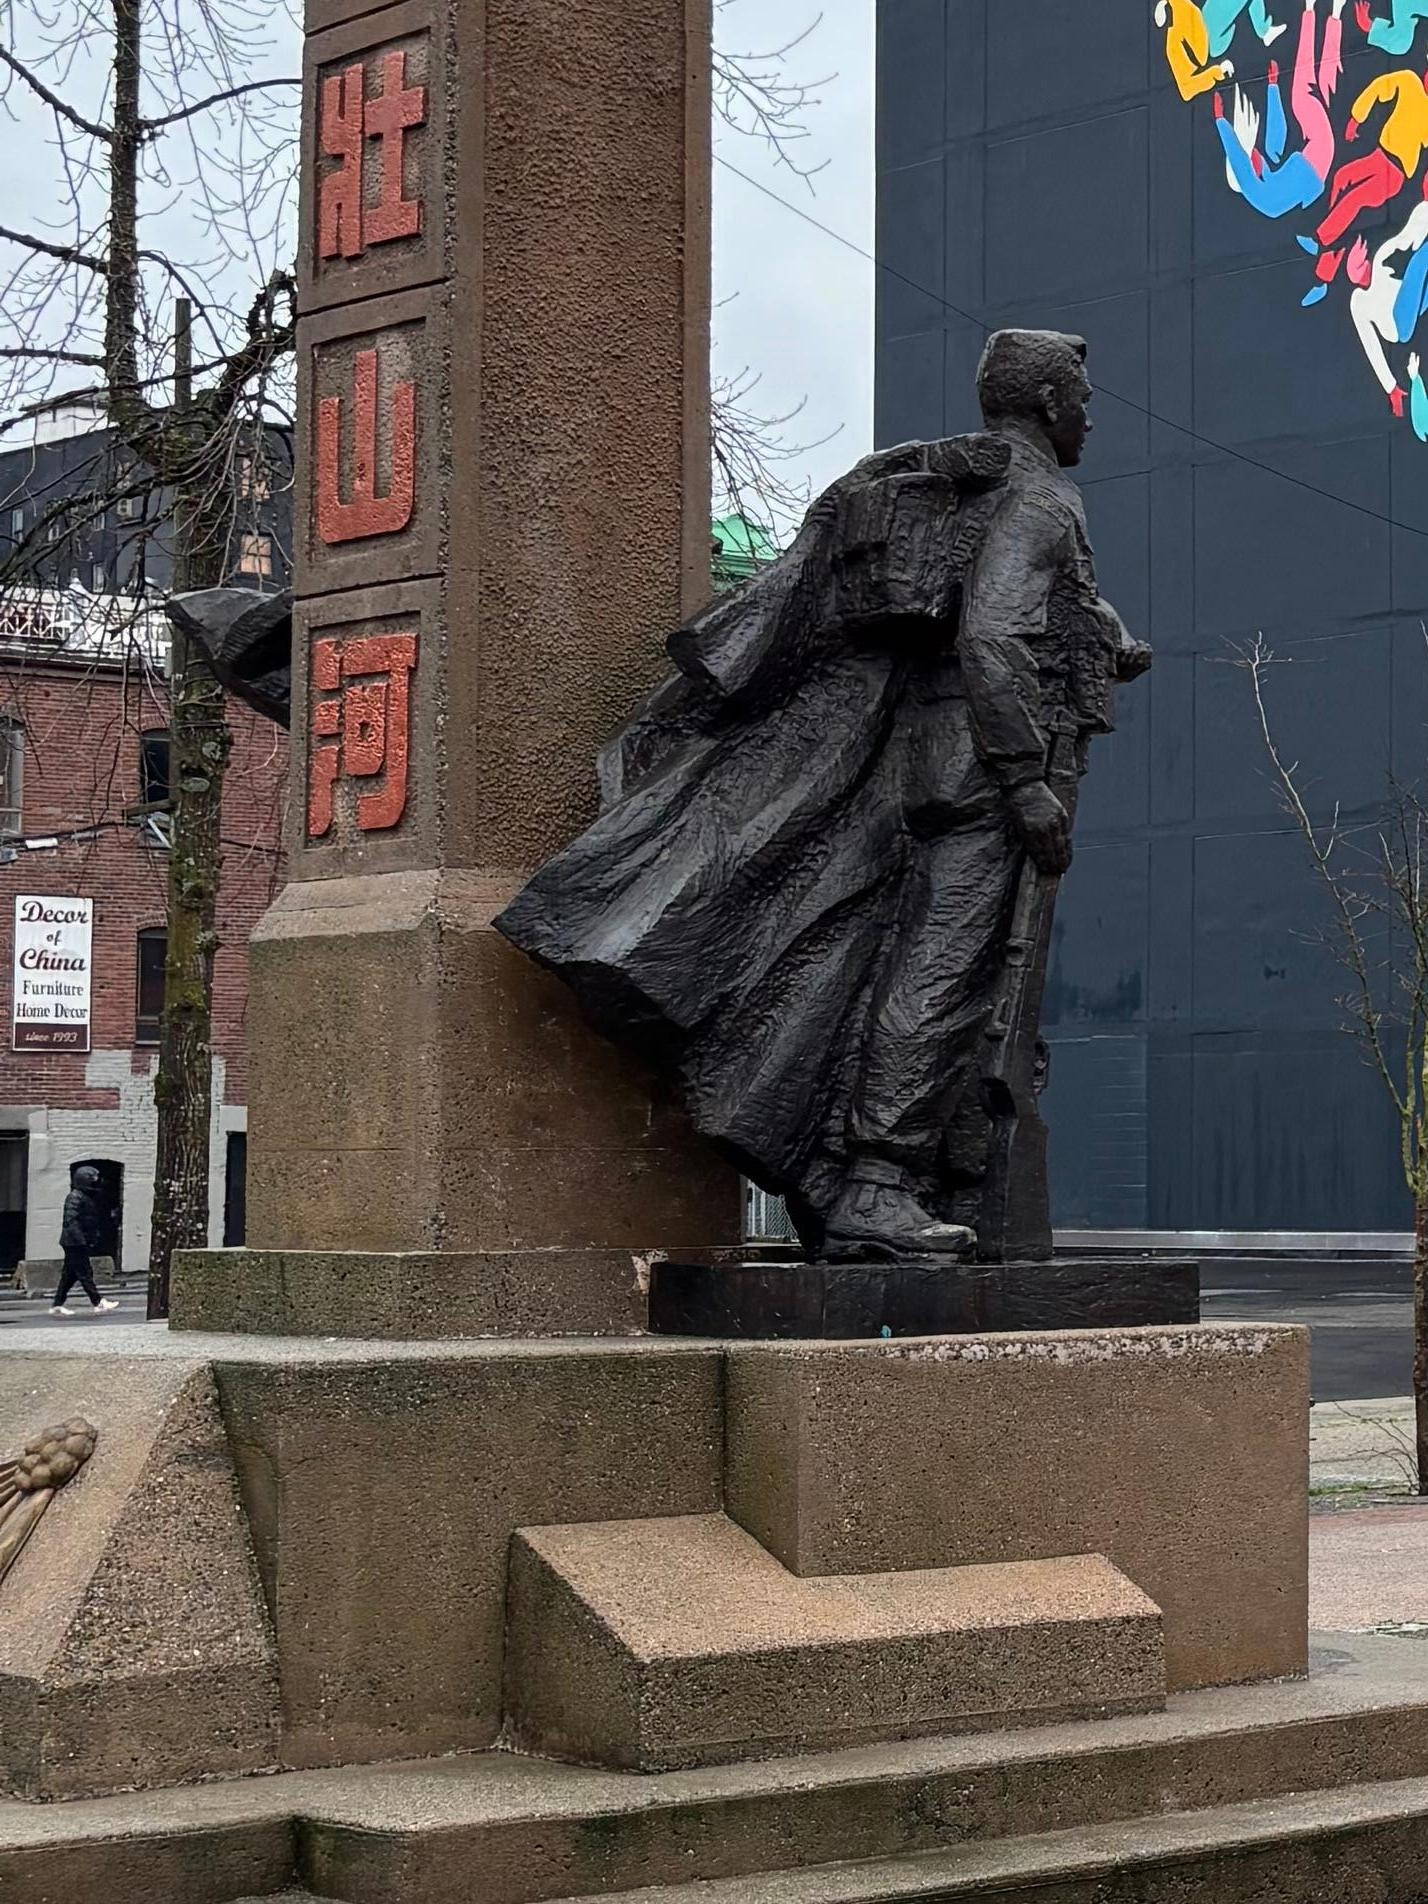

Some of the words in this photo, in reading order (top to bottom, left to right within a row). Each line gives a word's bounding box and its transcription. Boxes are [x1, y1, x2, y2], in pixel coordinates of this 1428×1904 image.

[20, 900, 88, 924] Decor
[46, 930, 62, 946] of
[20, 948, 86, 972] China
[23, 980, 84, 997] Furniture
[16, 1002, 51, 1018] Home
[54, 1003, 88, 1019] Decor
